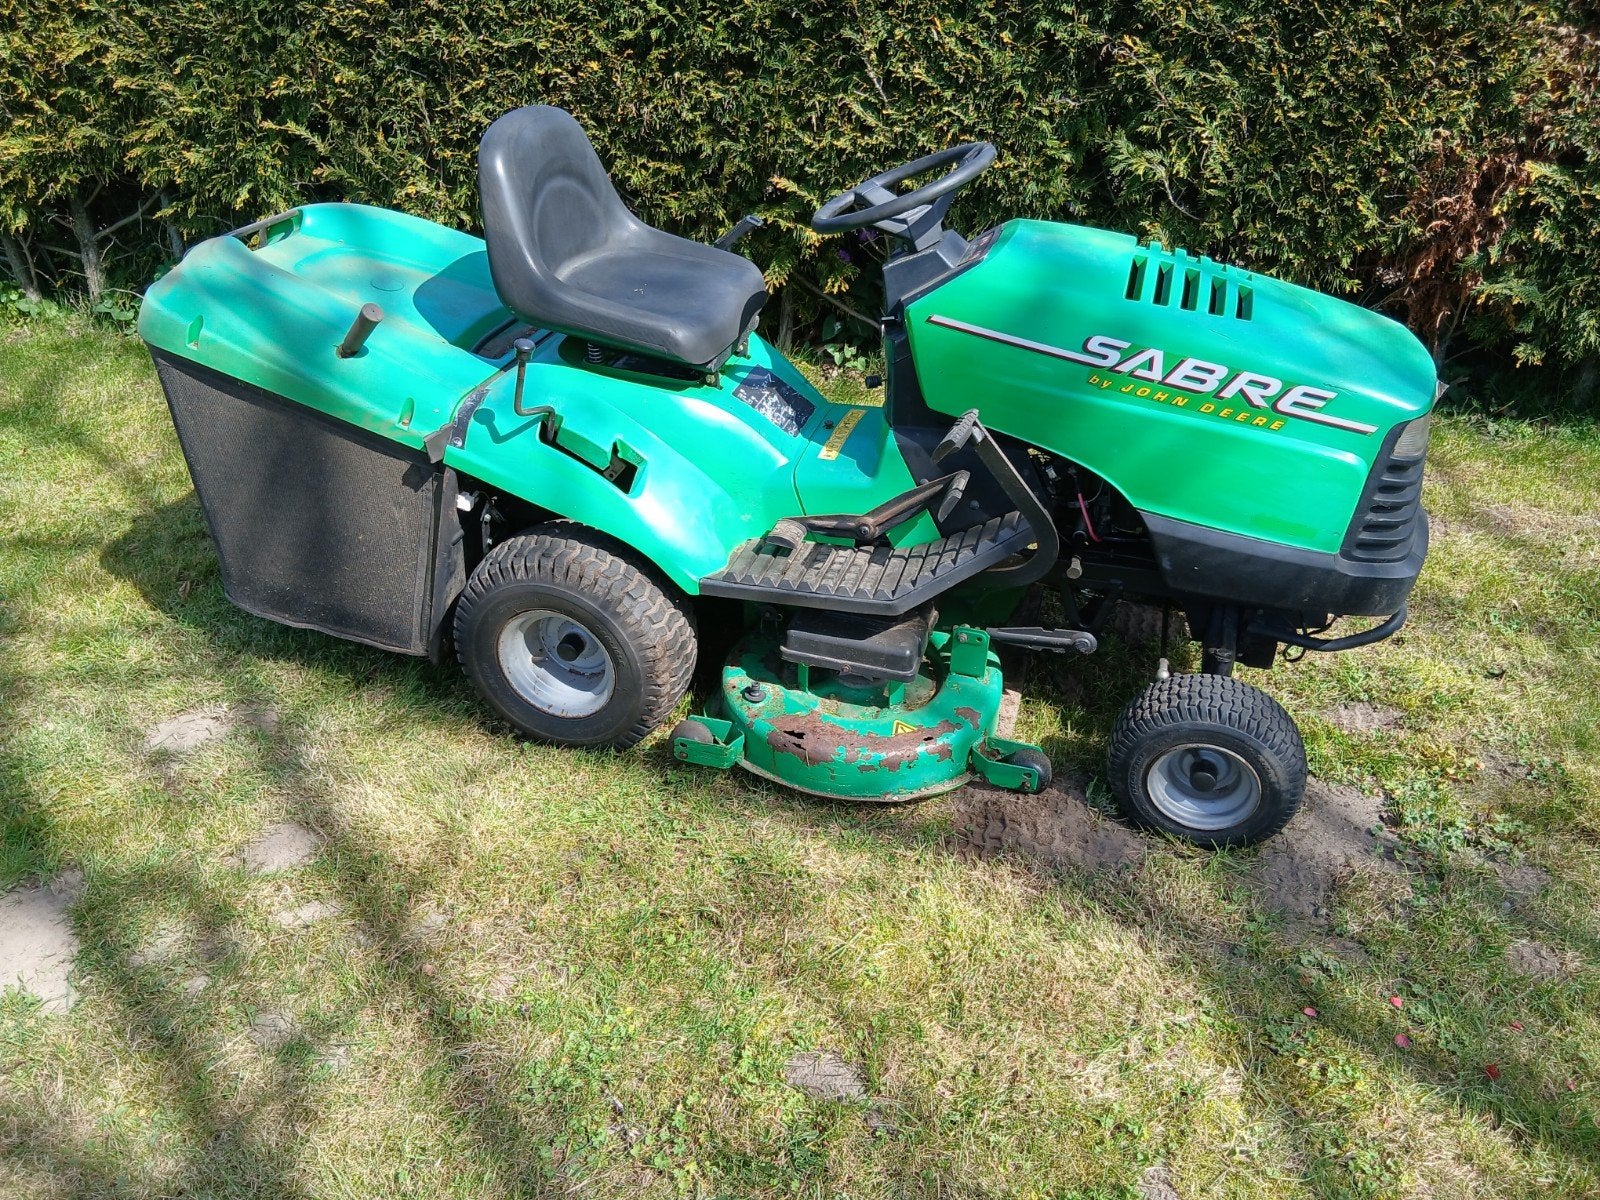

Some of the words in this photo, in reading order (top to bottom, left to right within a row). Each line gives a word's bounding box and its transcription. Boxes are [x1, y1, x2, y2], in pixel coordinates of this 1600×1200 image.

[1082, 335, 1343, 418] SABRE
[1087, 374, 1112, 389] by
[1120, 383, 1190, 406] JOHN
[1199, 402, 1286, 431] DEERE
